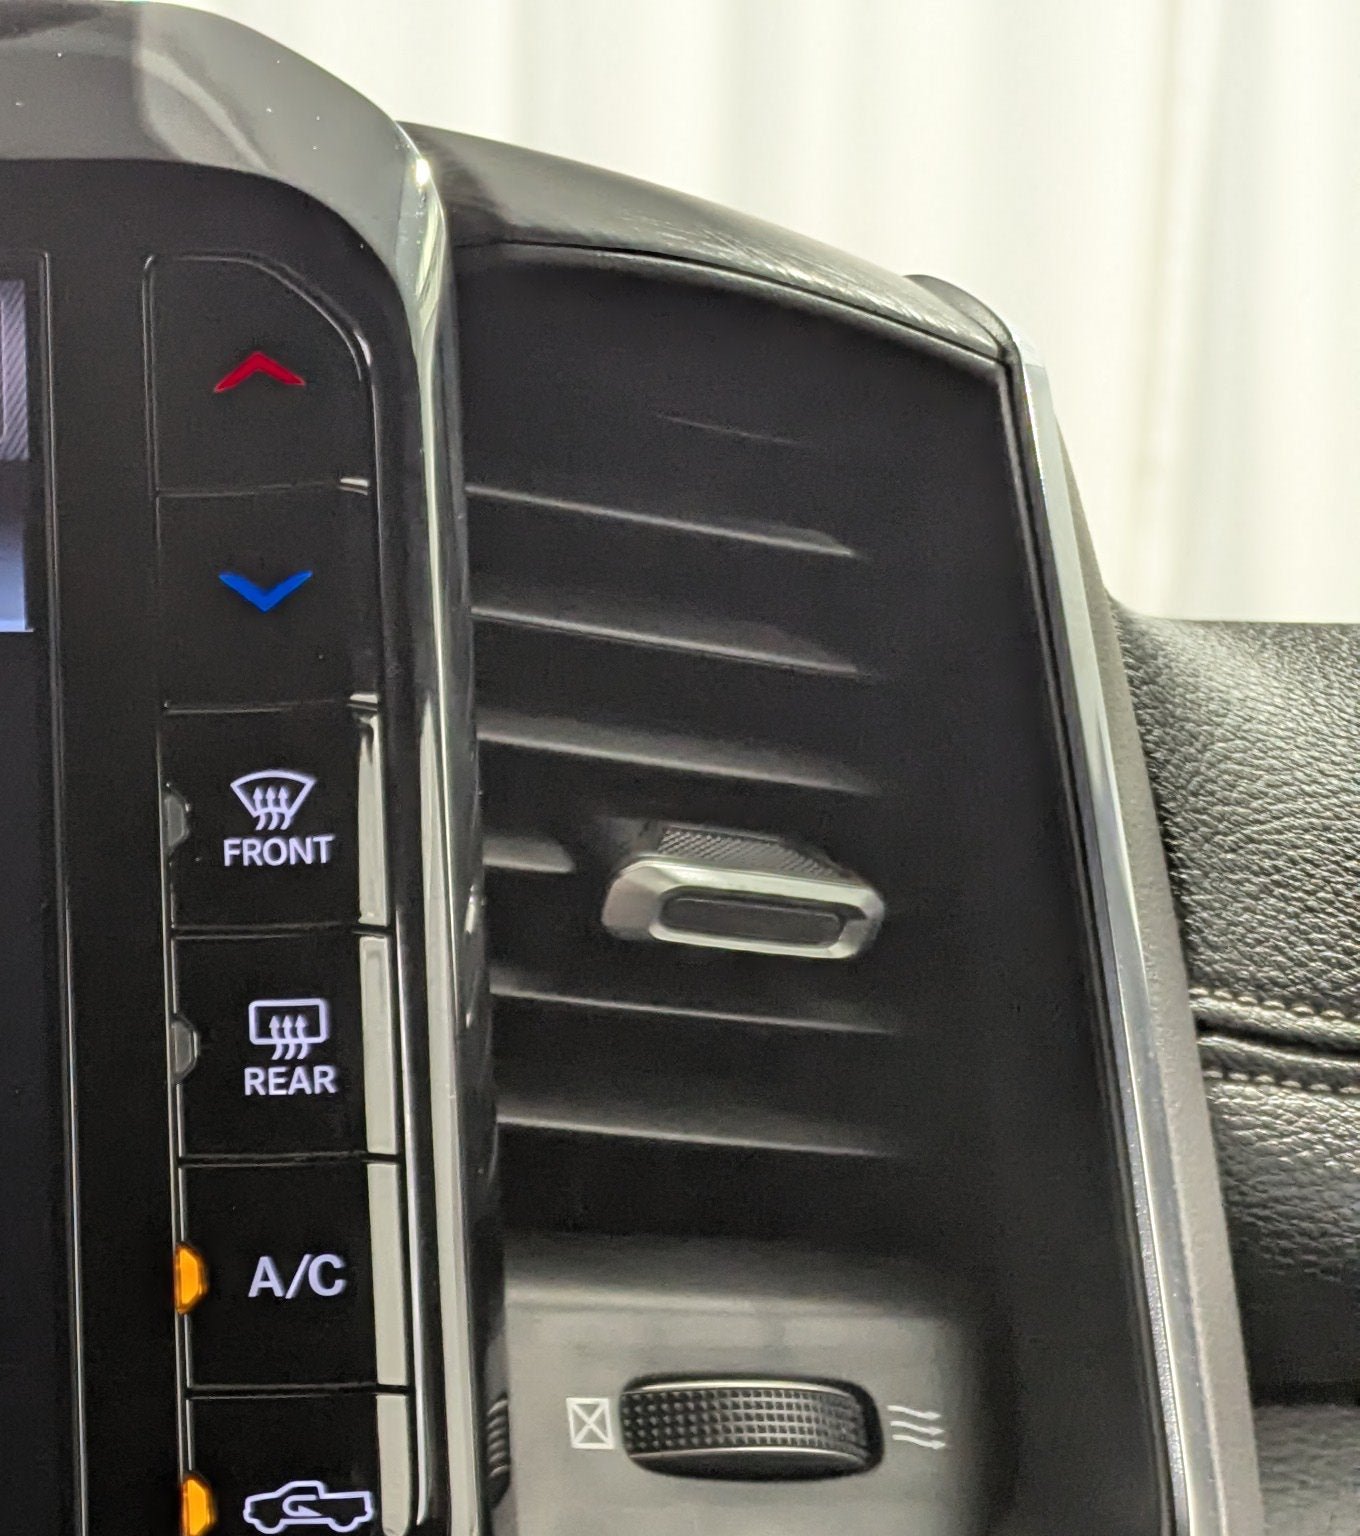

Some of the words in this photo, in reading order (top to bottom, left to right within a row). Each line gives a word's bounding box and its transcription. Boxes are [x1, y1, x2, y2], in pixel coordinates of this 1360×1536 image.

[223, 835, 335, 867] FRONT
[244, 1065, 337, 1096] REAR
[248, 1253, 345, 1300] A/C
